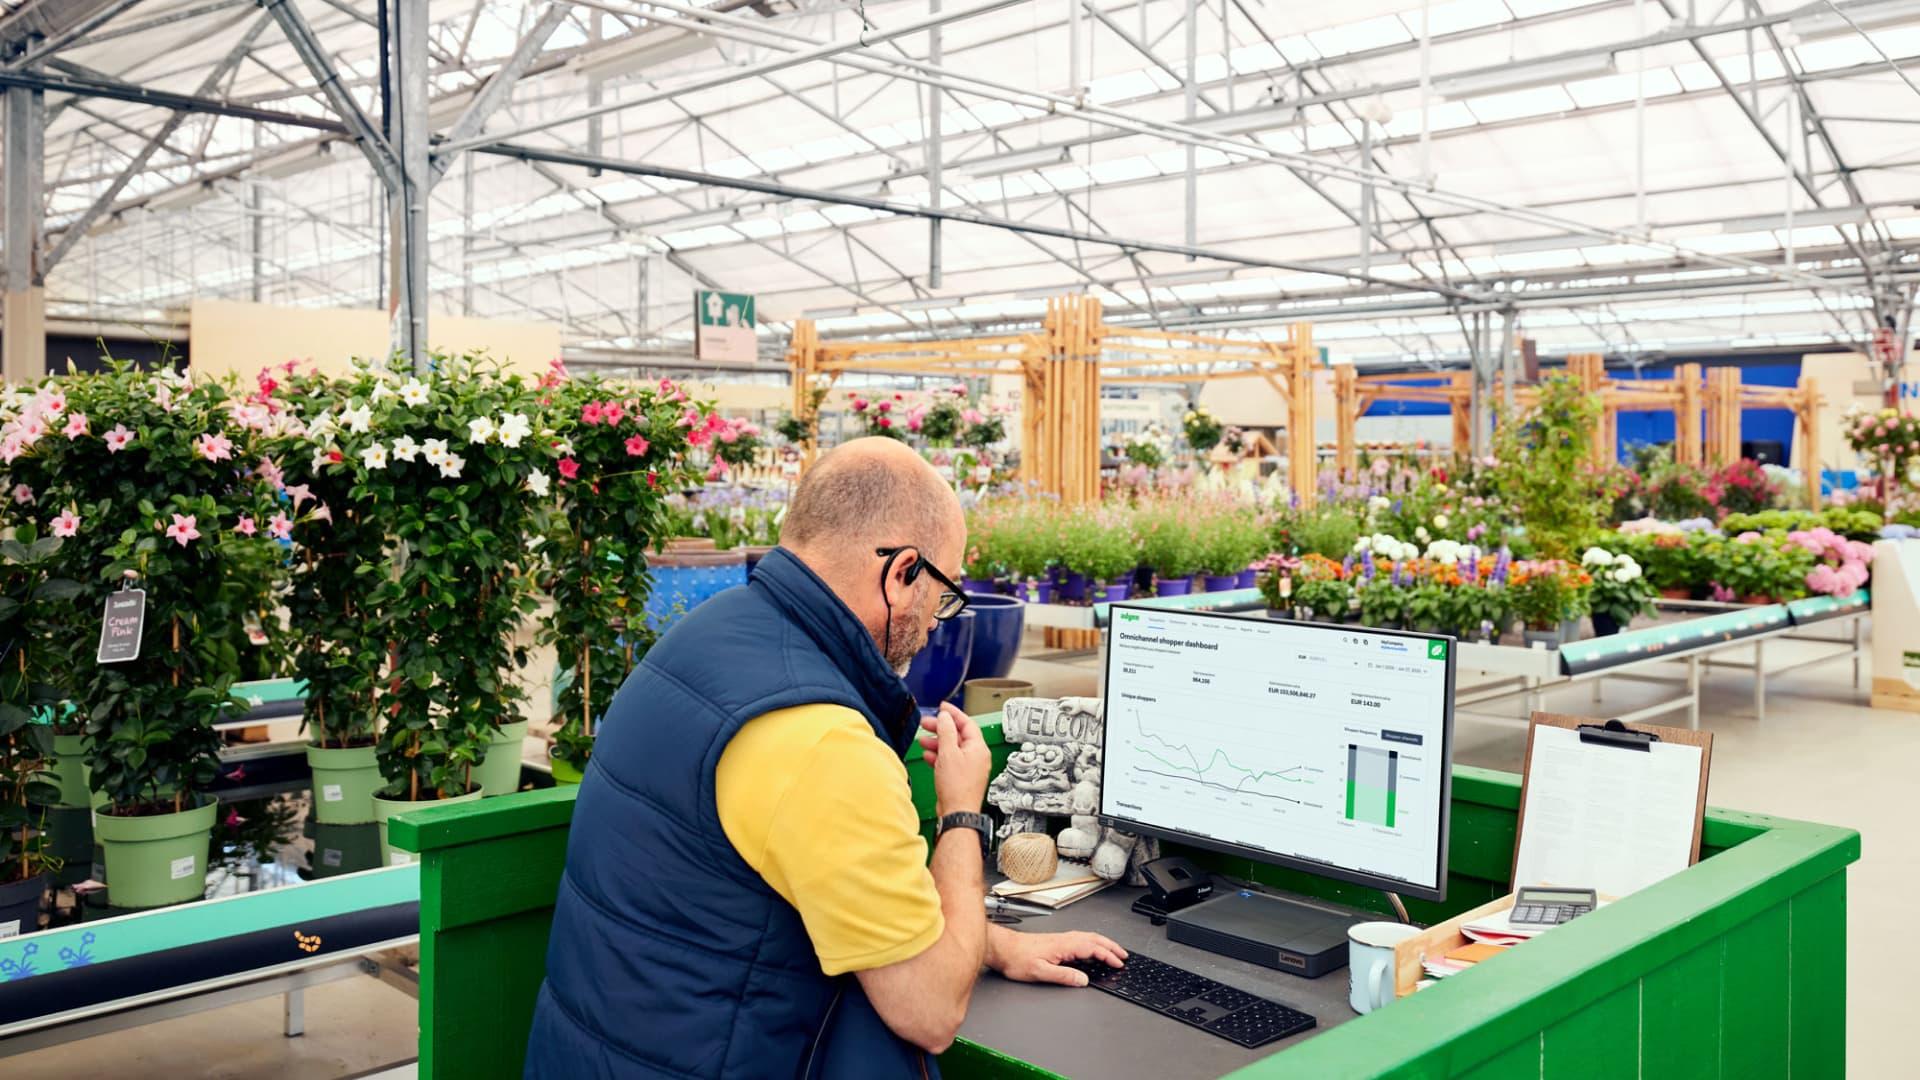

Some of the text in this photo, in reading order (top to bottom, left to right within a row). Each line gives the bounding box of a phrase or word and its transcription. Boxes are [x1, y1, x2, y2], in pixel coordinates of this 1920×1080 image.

[1119, 632, 1158, 643] Omnichannel
[1159, 637, 1184, 647] shopper
[1185, 640, 1218, 650] dashboard
[1280, 954, 1304, 966] Lenovo
